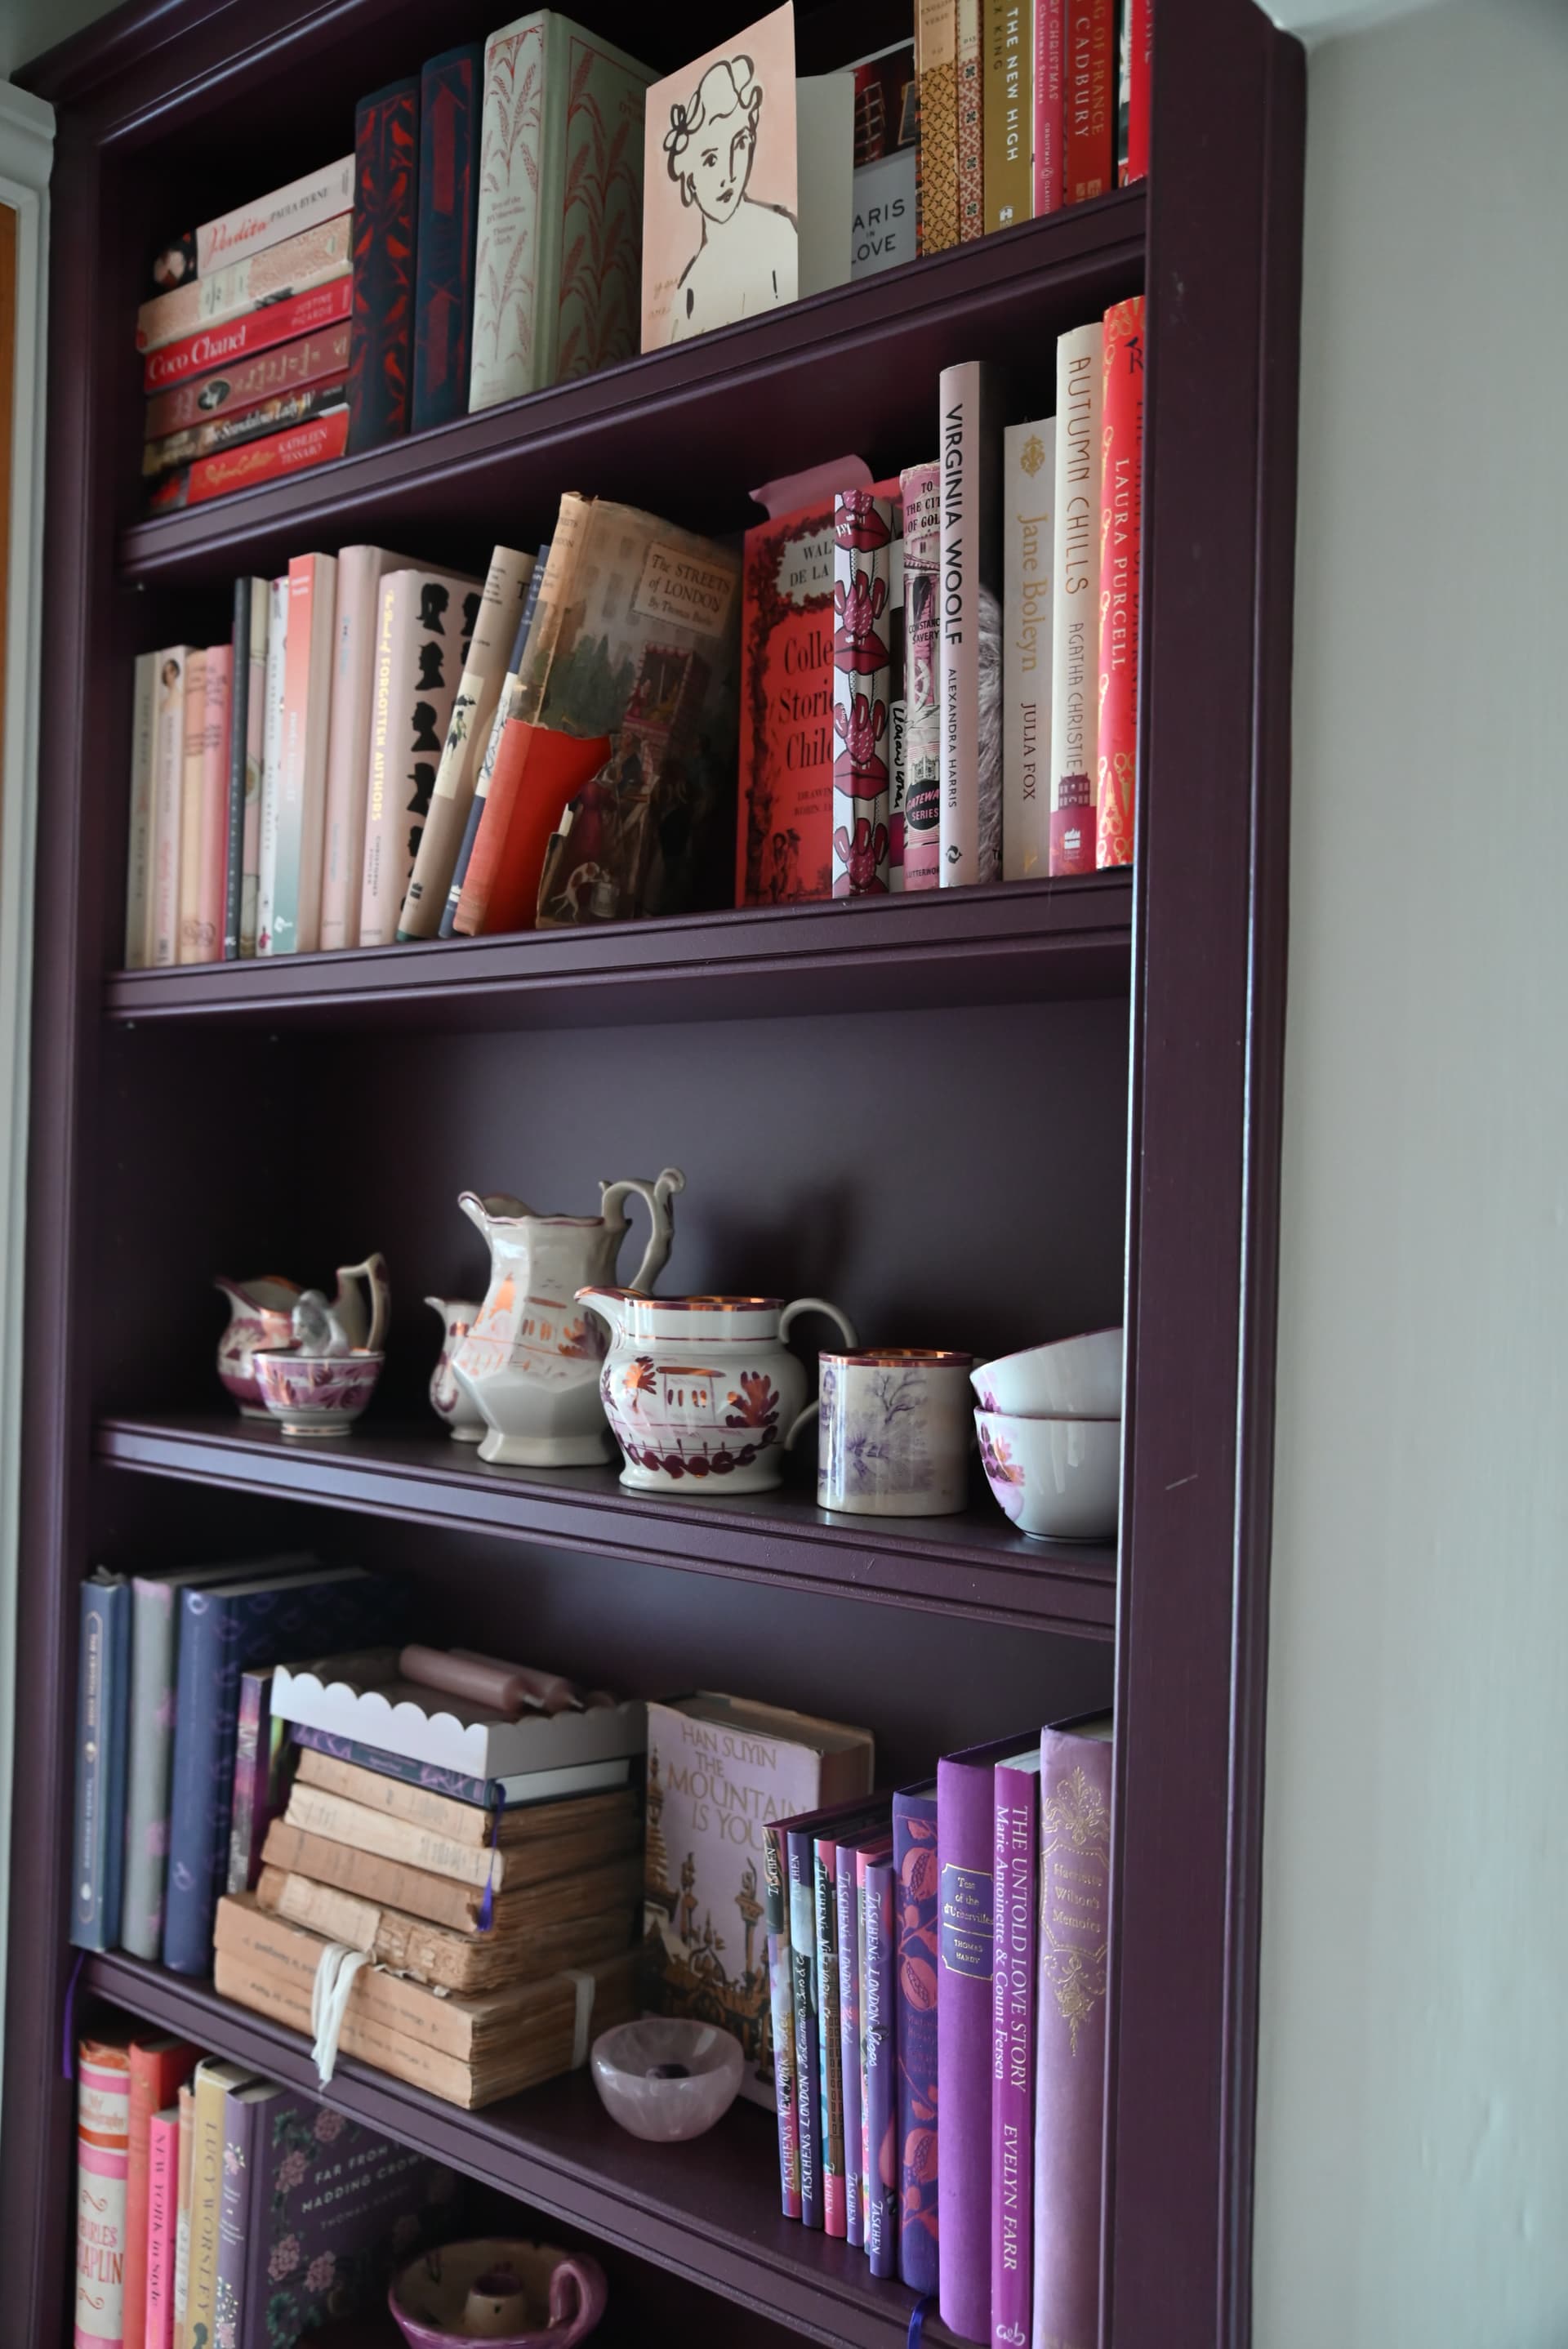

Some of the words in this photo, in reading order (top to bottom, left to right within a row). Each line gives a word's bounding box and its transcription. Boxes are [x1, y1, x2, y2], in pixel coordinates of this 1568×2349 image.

[1006, 7, 1019, 48] THE
[1092, 27, 1105, 50] OF
[1006, 56, 1019, 99] NEW
[1049, 19, 1060, 100] CHRISTMAS
[1074, 16, 1090, 137] CADBURY
[1092, 60, 1105, 136] FRANCE
[1006, 109, 1019, 162] HIGH
[852, 198, 905, 234] ARIS
[852, 234, 896, 264] OVE
[149, 354, 189, 381] Coco
[191, 324, 246, 363] Chanel
[1067, 356, 1092, 484] AUTUMN
[921, 480, 933, 493] TO
[945, 403, 964, 529] VIRGINIA
[906, 501, 922, 517] THE
[925, 497, 941, 510] CIT
[907, 519, 919, 533] OF
[921, 515, 940, 528] GOL
[1113, 457, 1130, 545] LAURA
[804, 539, 835, 560] WAL
[1018, 513, 1049, 571] Jane
[1065, 496, 1090, 595] CHILLS
[648, 576, 662, 593] of
[664, 579, 719, 613] LONDON
[652, 554, 671, 573] The
[675, 562, 731, 595] STREETS
[791, 568, 807, 587] DE
[813, 563, 829, 580] LA
[944, 538, 964, 645] WOOLF
[908, 617, 941, 635] COSTANC
[911, 628, 940, 644] SAVERY
[1020, 578, 1049, 672] Boleyn
[1111, 555, 1129, 671] PURCELL
[1066, 622, 1085, 687] AGATHA
[375, 657, 391, 747] FORGOTTEN
[947, 668, 958, 754] ALEXANDRA
[1021, 702, 1036, 757] JULIA
[1066, 692, 1085, 769] CHRISTIE
[372, 751, 385, 822] AUTHORS
[906, 787, 941, 813] GATEWA
[947, 759, 957, 808] HARRIS
[1022, 762, 1036, 801] FOX
[911, 808, 940, 822] SERIES
[680, 1721, 717, 1752] HAN
[723, 1735, 777, 1772] SUYIN
[695, 1750, 724, 1778] THE
[692, 1801, 709, 1832] IS
[996, 1805, 1010, 1852] Marie
[1012, 1805, 1028, 1852] THE
[955, 1892, 964, 1904] of
[965, 1895, 980, 1906] the
[957, 1877, 976, 1891] Tess
[995, 1856, 1010, 1944] Antoinette
[1011, 1856, 1028, 1952] UNTOLD
[954, 1939, 983, 1953] THOMAS
[956, 1951, 981, 1964] HARDY
[995, 1949, 1009, 1962] &
[840, 1947, 853, 2003] LONDON
[868, 1969, 880, 2027] LONDON
[994, 1971, 1009, 2023] Count
[1011, 1956, 1027, 2015] LOVE
[867, 2028, 883, 2067] Shops
[994, 2030, 1009, 2079] Fersen
[1010, 2021, 1027, 2093] STORY
[775, 2056, 791, 2091] YORK
[777, 2089, 791, 2121] NEW
[799, 2070, 813, 2128] LONDON
[203, 2122, 217, 2192] LUCY
[314, 2164, 342, 2186] FAR
[348, 2145, 389, 2170] FROM
[1003, 2123, 1018, 2209] EVELYN
[301, 2173, 372, 2214] MADDING
[823, 2162, 836, 2214] TASCHEN
[846, 2173, 858, 2226] TASCHEN
[78, 2213, 118, 2248] ARLES
[871, 2200, 884, 2256] TASCHEN
[1003, 2214, 1018, 2271] FARR
[77, 2236, 124, 2284] APLIN
[197, 2197, 216, 2318] WORSLEY
